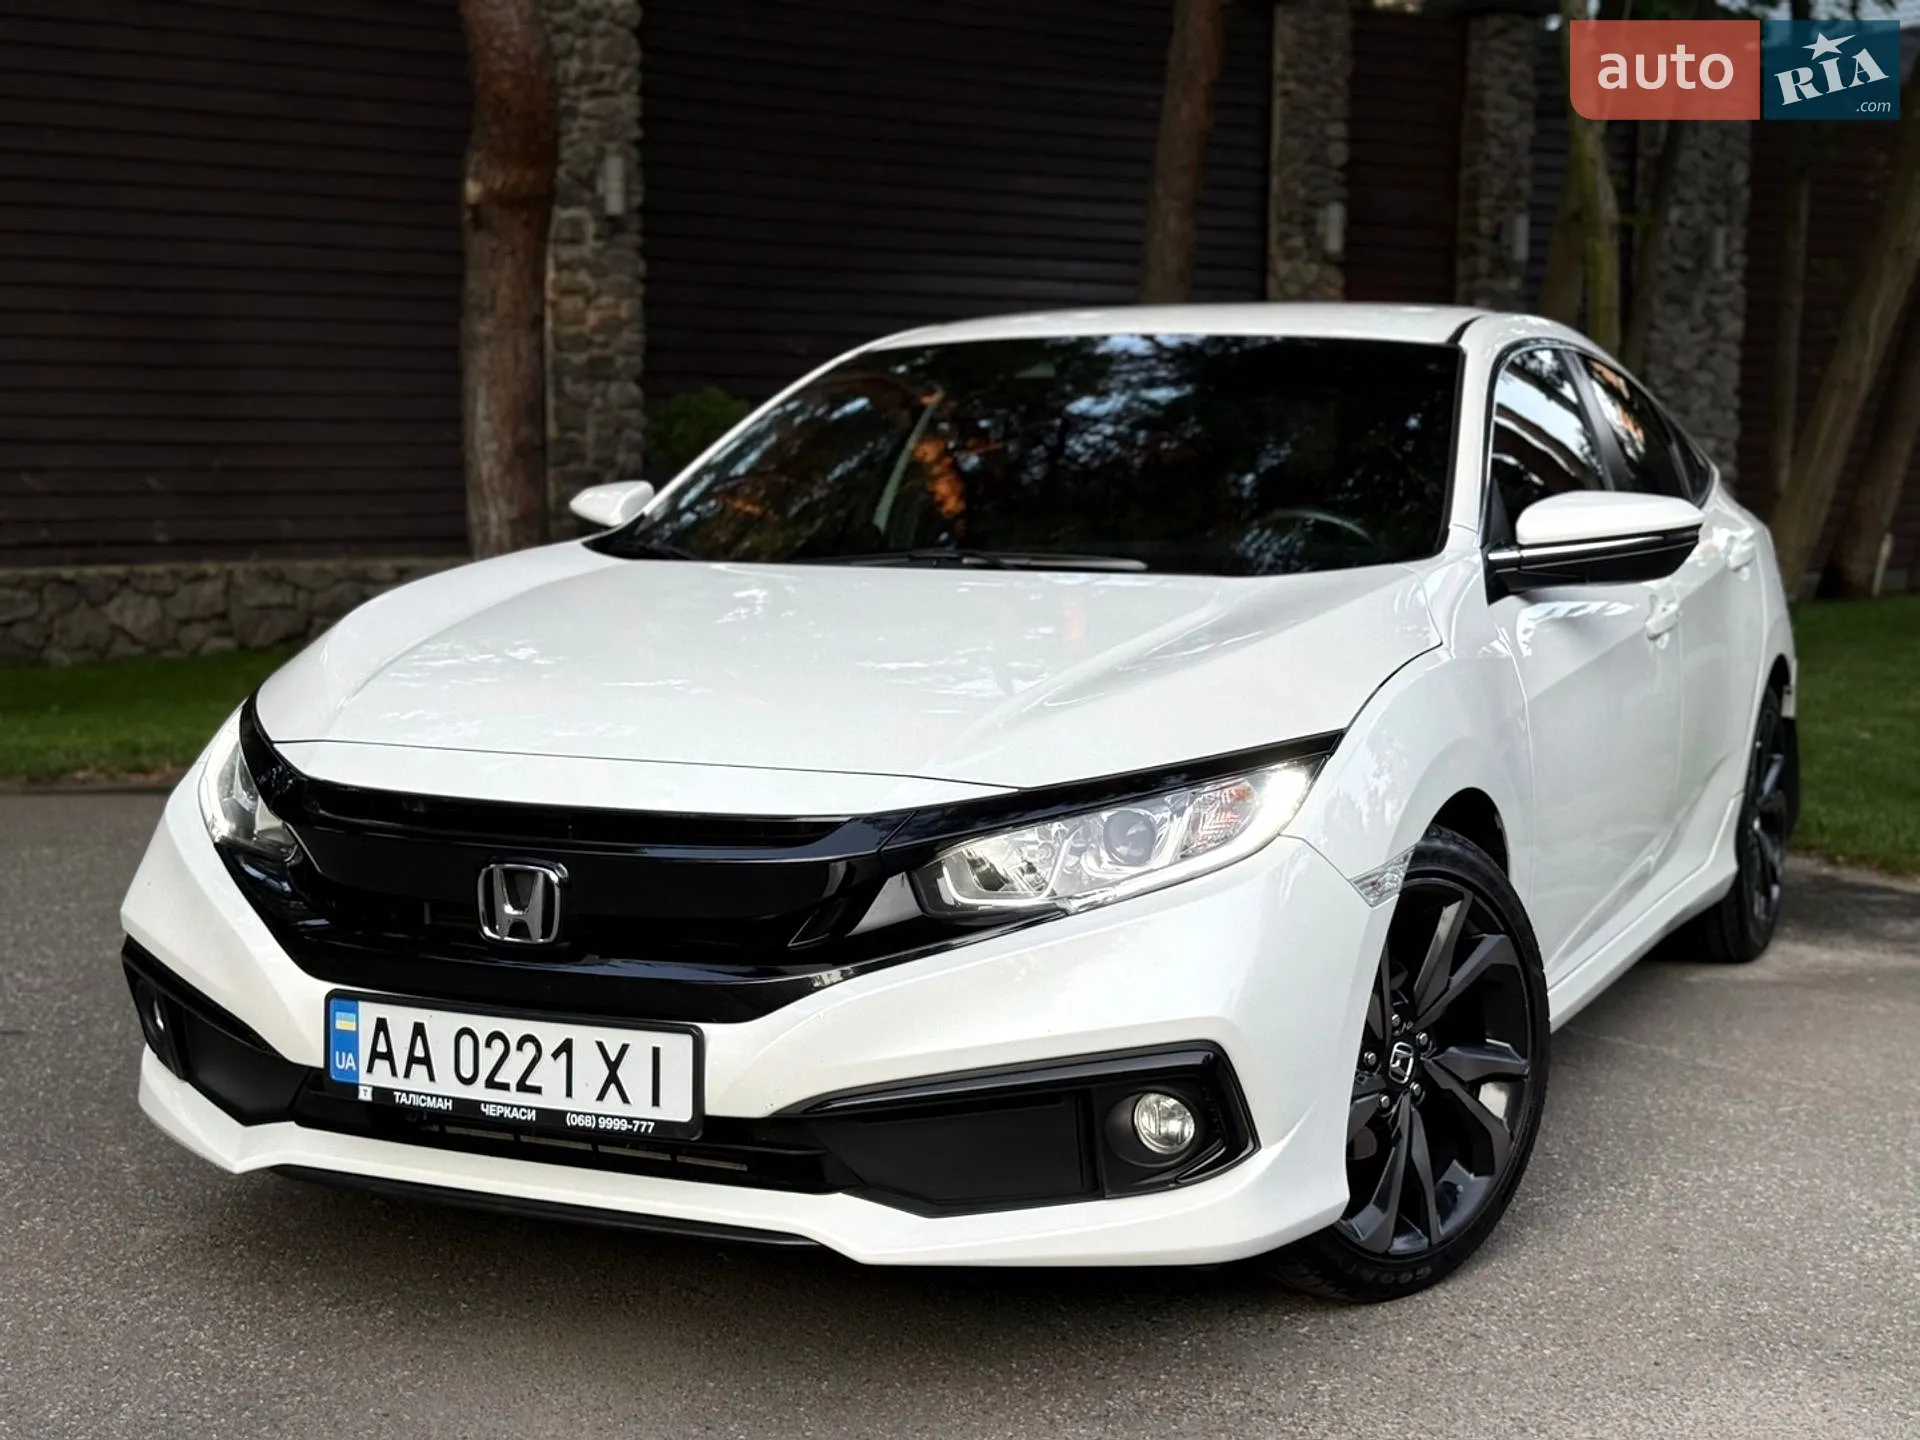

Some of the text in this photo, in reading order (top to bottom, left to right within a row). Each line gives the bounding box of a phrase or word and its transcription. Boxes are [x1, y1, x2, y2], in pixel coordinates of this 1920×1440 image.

[335, 1051, 357, 1071] UA
[366, 1016, 438, 1083] AA
[454, 1026, 575, 1099] 0221
[393, 1091, 655, 1134] ТАЛІСМАН ЧЕРКАСИ (068) 9999-777
